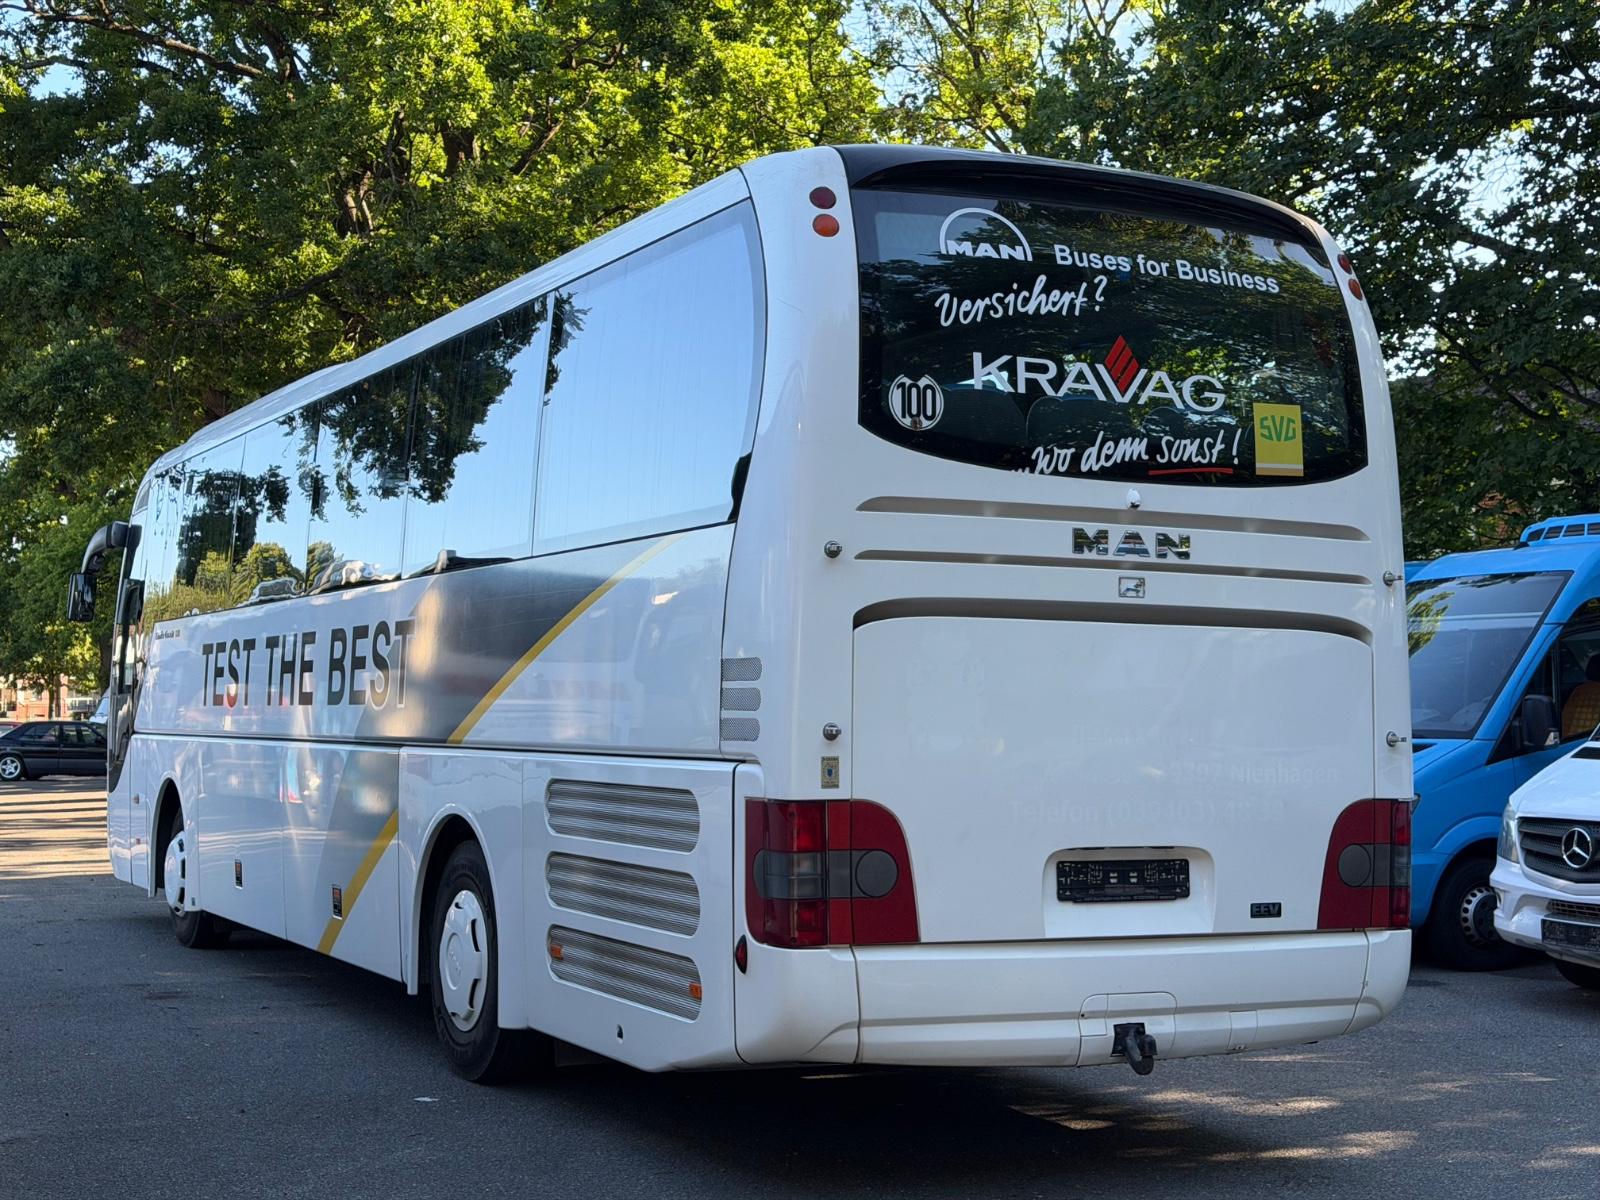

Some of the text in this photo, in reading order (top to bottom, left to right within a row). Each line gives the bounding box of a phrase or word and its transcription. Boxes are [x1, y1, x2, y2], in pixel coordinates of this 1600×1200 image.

[946, 239, 1026, 262] MAN
[1053, 244, 1281, 295] Buses for Business
[896, 381, 937, 422] 100
[972, 351, 1226, 413] KRAVAG
[1260, 414, 1297, 443] SVG
[1080, 431, 1149, 473] denn
[1072, 527, 1191, 560] MAN
[202, 619, 416, 711] TEST THE BEST
[1251, 903, 1281, 917] EEV
